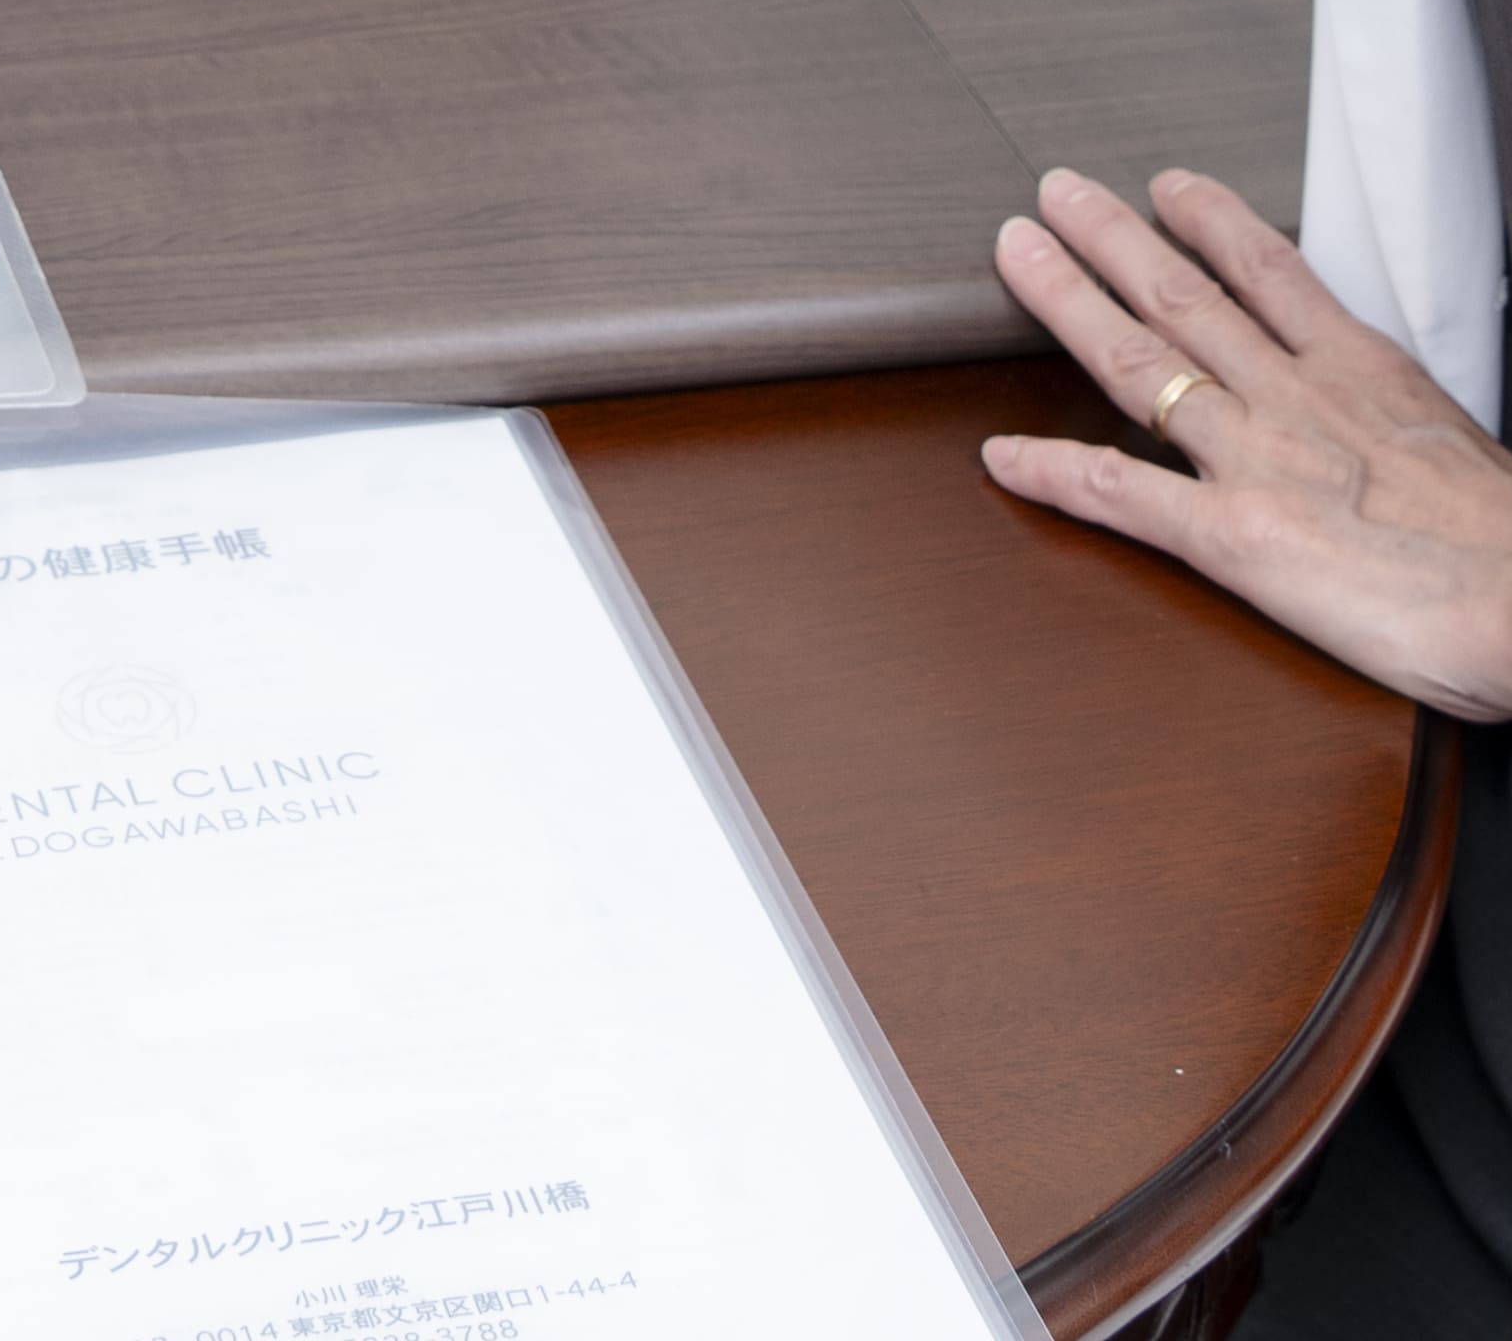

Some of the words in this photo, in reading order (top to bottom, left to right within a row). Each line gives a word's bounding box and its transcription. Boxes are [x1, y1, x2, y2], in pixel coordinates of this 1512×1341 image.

[171, 751, 381, 801] CLINIC
[58, 1179, 592, 1281] デンタルクリニック江戸川橋
[287, 1270, 639, 1338] 東京都文京区関口1-44-4
[294, 1284, 348, 1309] 小川
